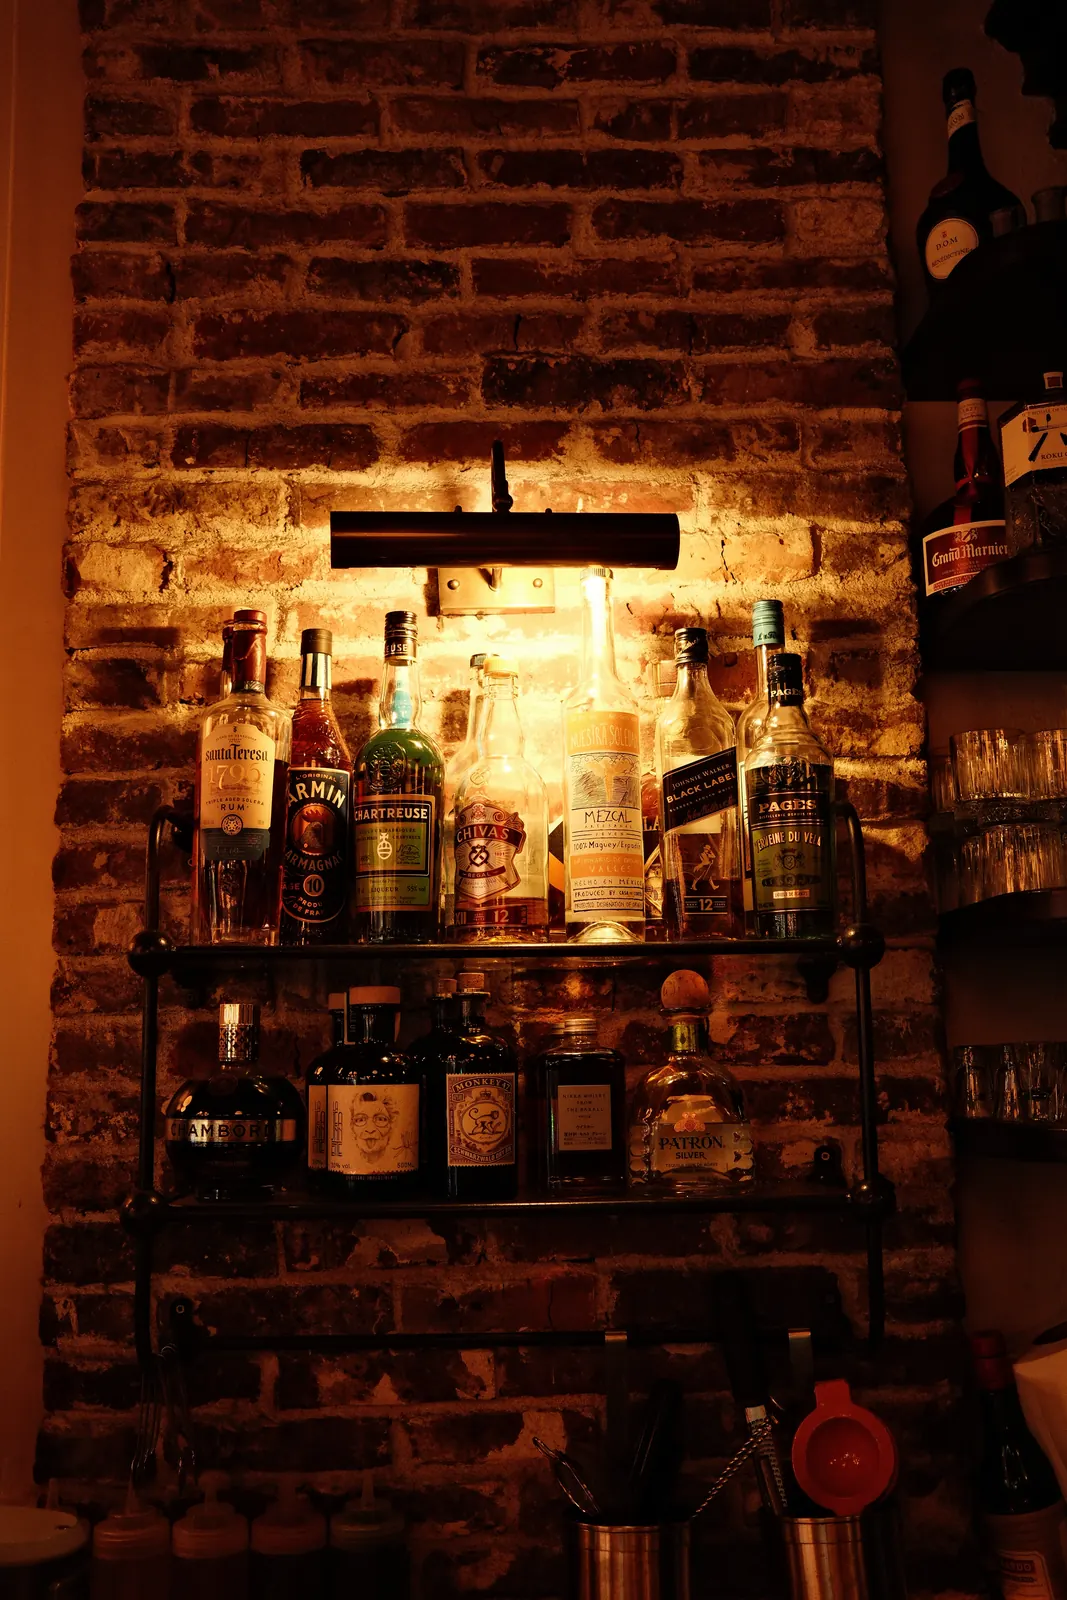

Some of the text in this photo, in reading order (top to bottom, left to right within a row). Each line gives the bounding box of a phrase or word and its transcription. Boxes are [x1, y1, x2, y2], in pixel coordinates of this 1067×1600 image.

[1041, 452, 1063, 460] ROKU
[666, 772, 736, 804] BLACK LABEL
[672, 774, 702, 791] JOHNNIE
[288, 780, 346, 809] ARMIN
[758, 798, 817, 814] PAGÈS
[355, 807, 428, 821] CHARTREUSE
[584, 810, 632, 824] MEZCAL
[456, 827, 510, 844] CHIVAS
[788, 831, 801, 842] DU
[804, 831, 822, 848] VELA
[468, 871, 491, 879] REGAL
[307, 879, 322, 894] 10
[574, 890, 606, 898] PRODUCED
[698, 898, 714, 911] 12
[494, 909, 510, 923] 12
[455, 1078, 502, 1092] MONKEY
[658, 1132, 724, 1150] PATRÓN
[675, 1151, 707, 1160] SILVER
